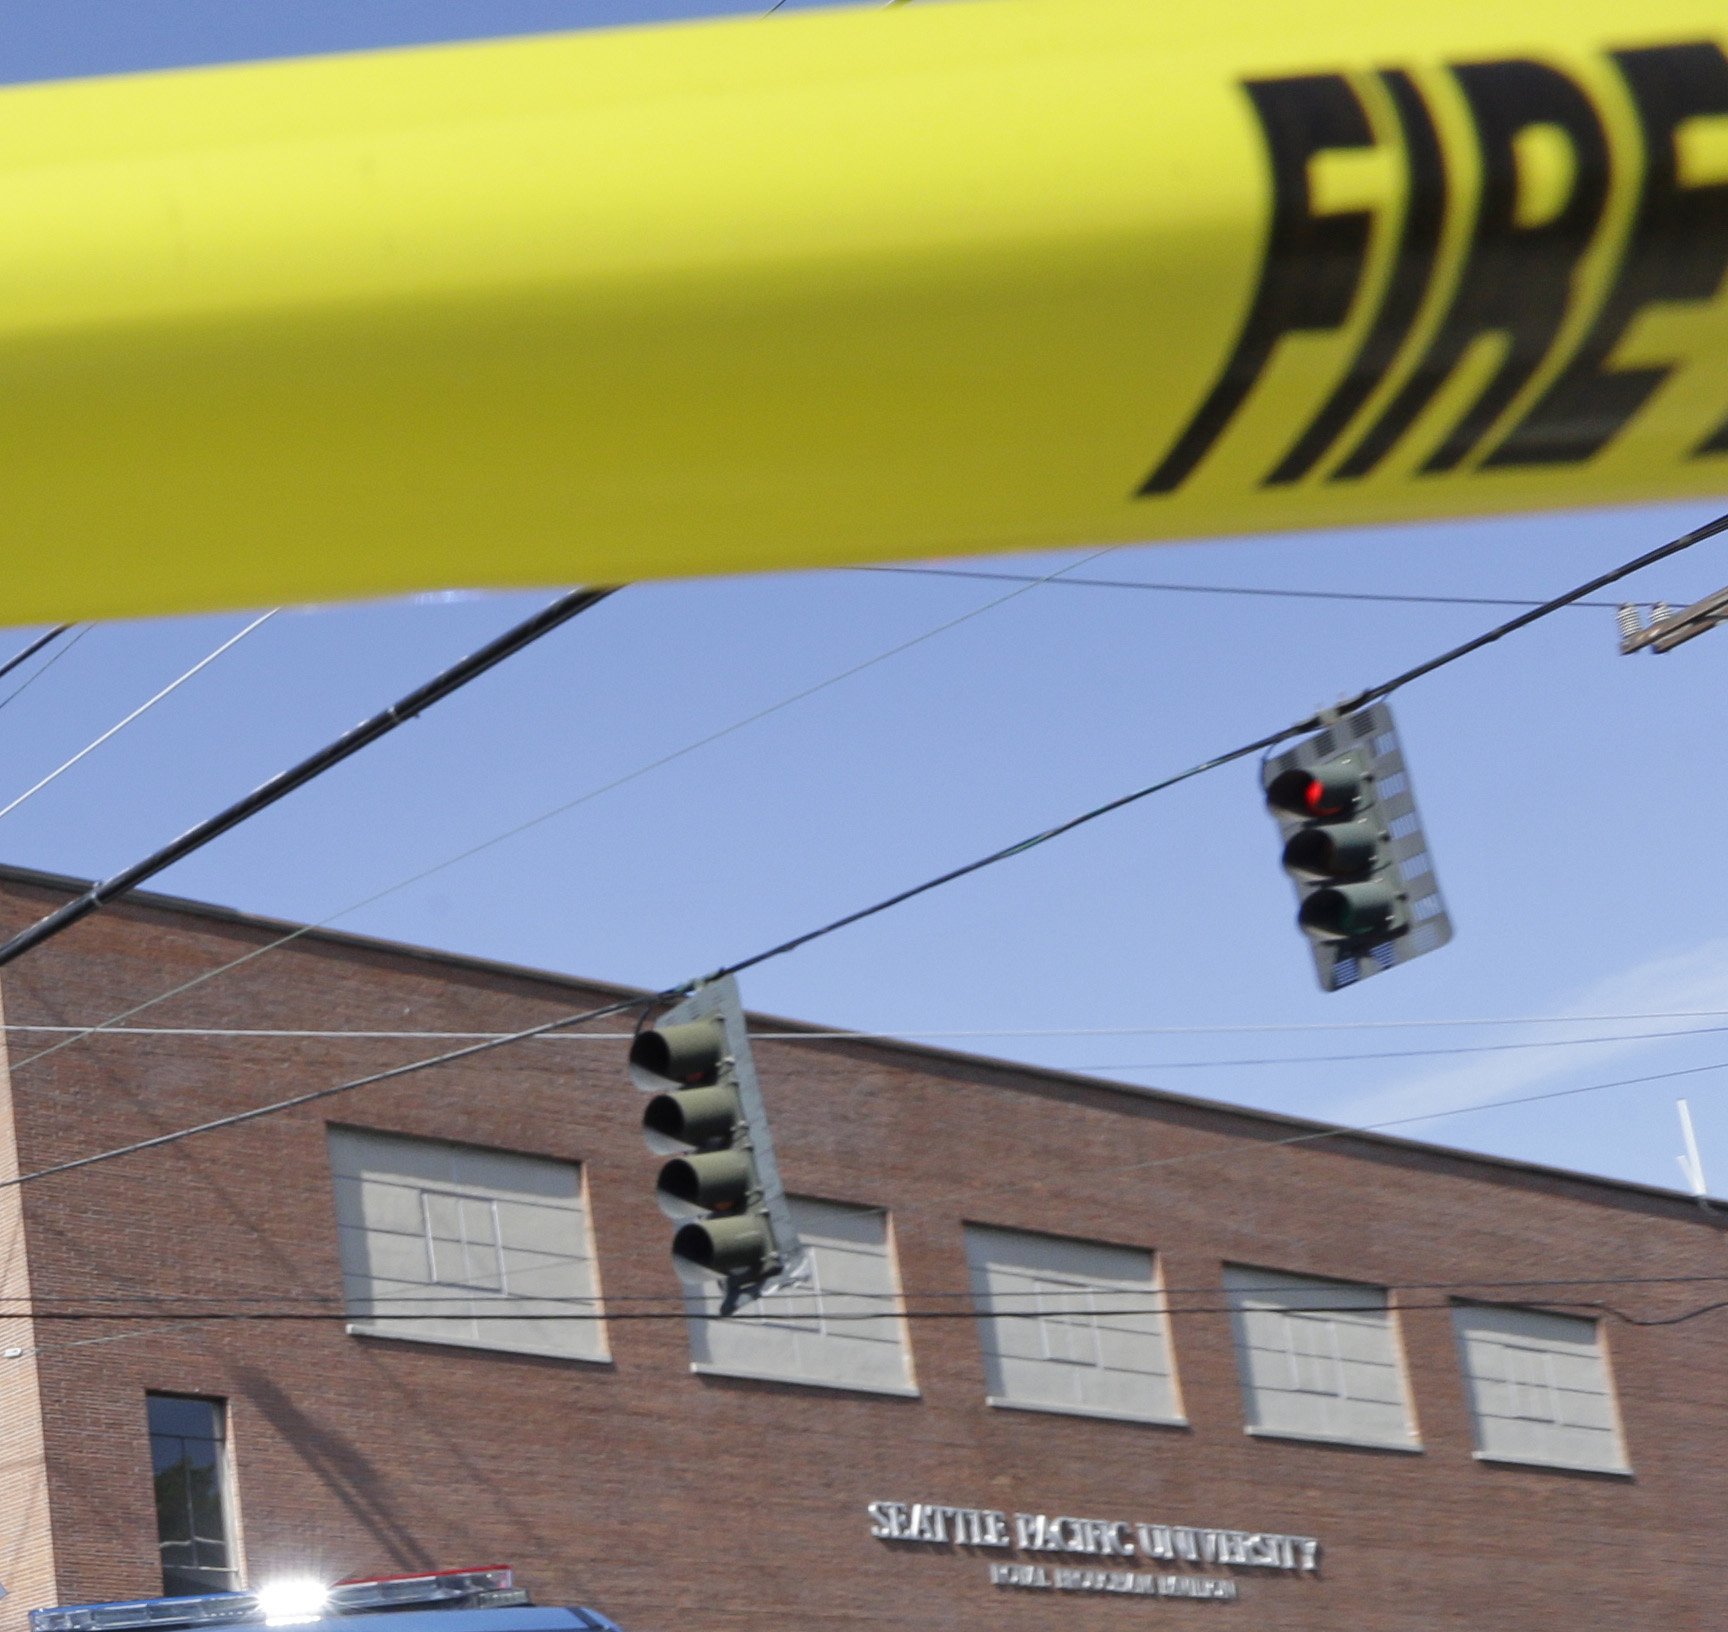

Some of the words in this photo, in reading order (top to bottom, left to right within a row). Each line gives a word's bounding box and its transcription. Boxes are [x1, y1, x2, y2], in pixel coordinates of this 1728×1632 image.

[1134, 41, 1728, 499] FIRE
[868, 1501, 1010, 1546] SEATTLE
[1013, 1512, 1135, 1557] PACIFIC
[1135, 1522, 1319, 1571] UNIVERSITY
